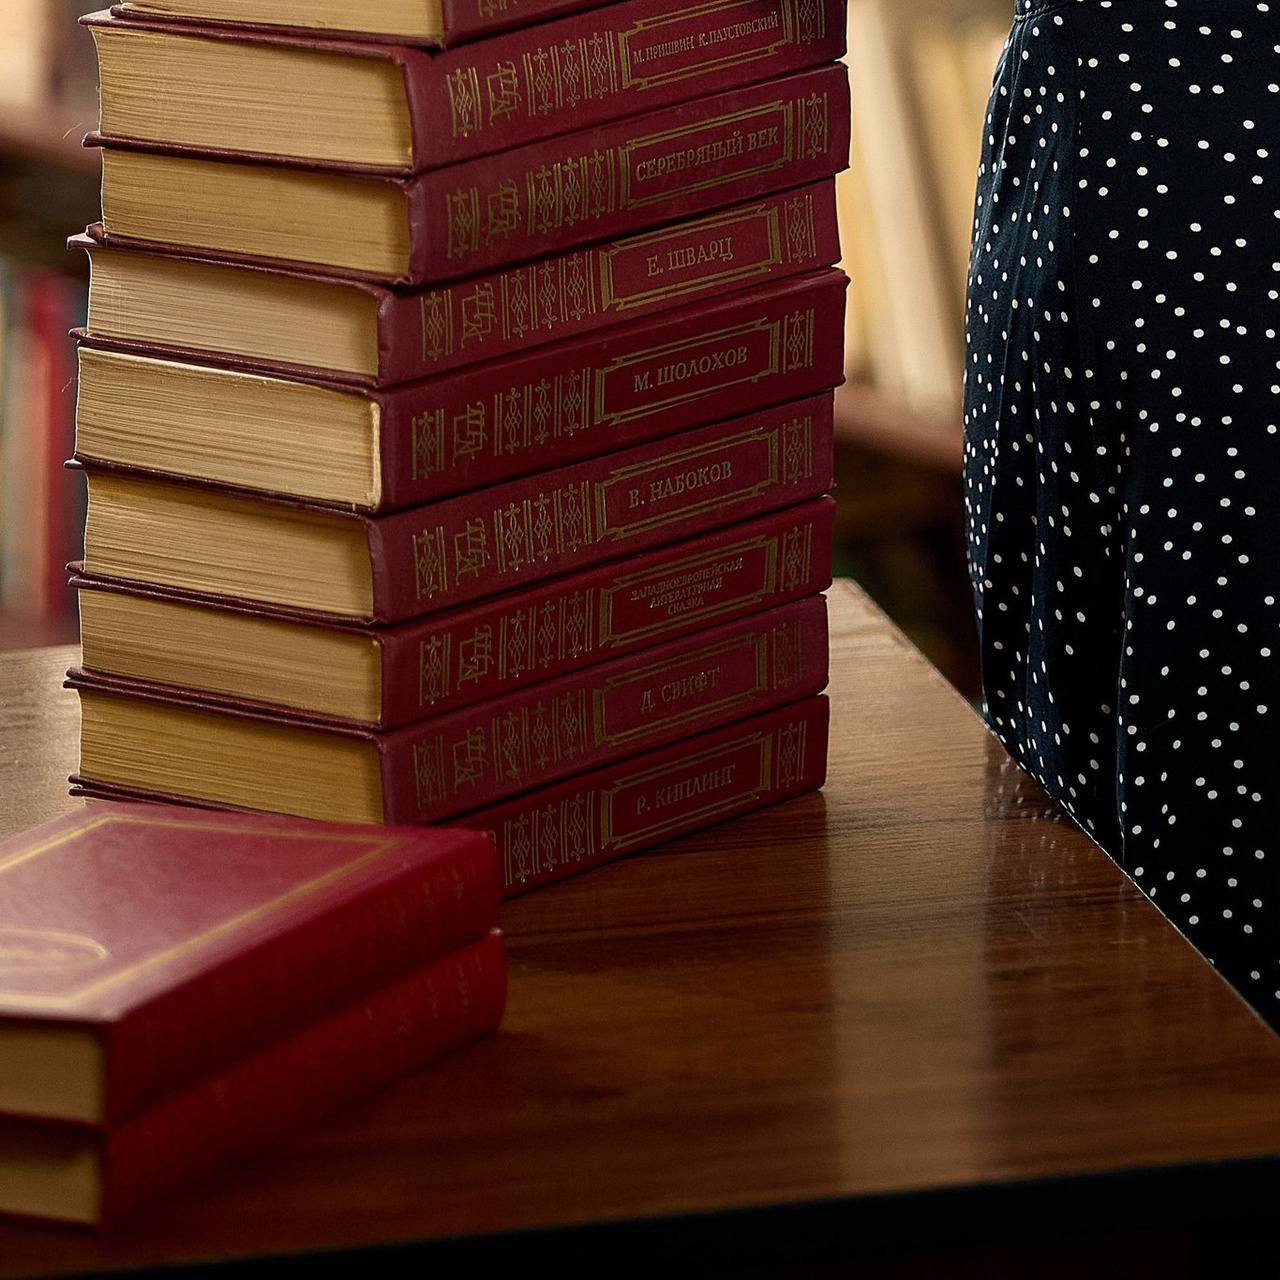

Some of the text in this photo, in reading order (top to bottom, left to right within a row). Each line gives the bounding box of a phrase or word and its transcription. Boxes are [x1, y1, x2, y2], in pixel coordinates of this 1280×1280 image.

[635, 126, 779, 182] СЕРЕБРЯНЫЙ ВЕК
[646, 237, 733, 277] Е. ШВАРЦ
[633, 346, 747, 393] М. ШОЛОХОВ
[628, 460, 732, 508] В. НАБОКОВ
[630, 557, 743, 601] ЗАПАДНОЕВРОПЕЙСКАЯ
[649, 577, 722, 609] ЛИТЕРАТУРНАЯ
[667, 597, 704, 615] СКАЗКА
[661, 666, 720, 704] СВИФТ
[636, 763, 736, 816] Р. КИПЛИНГ
